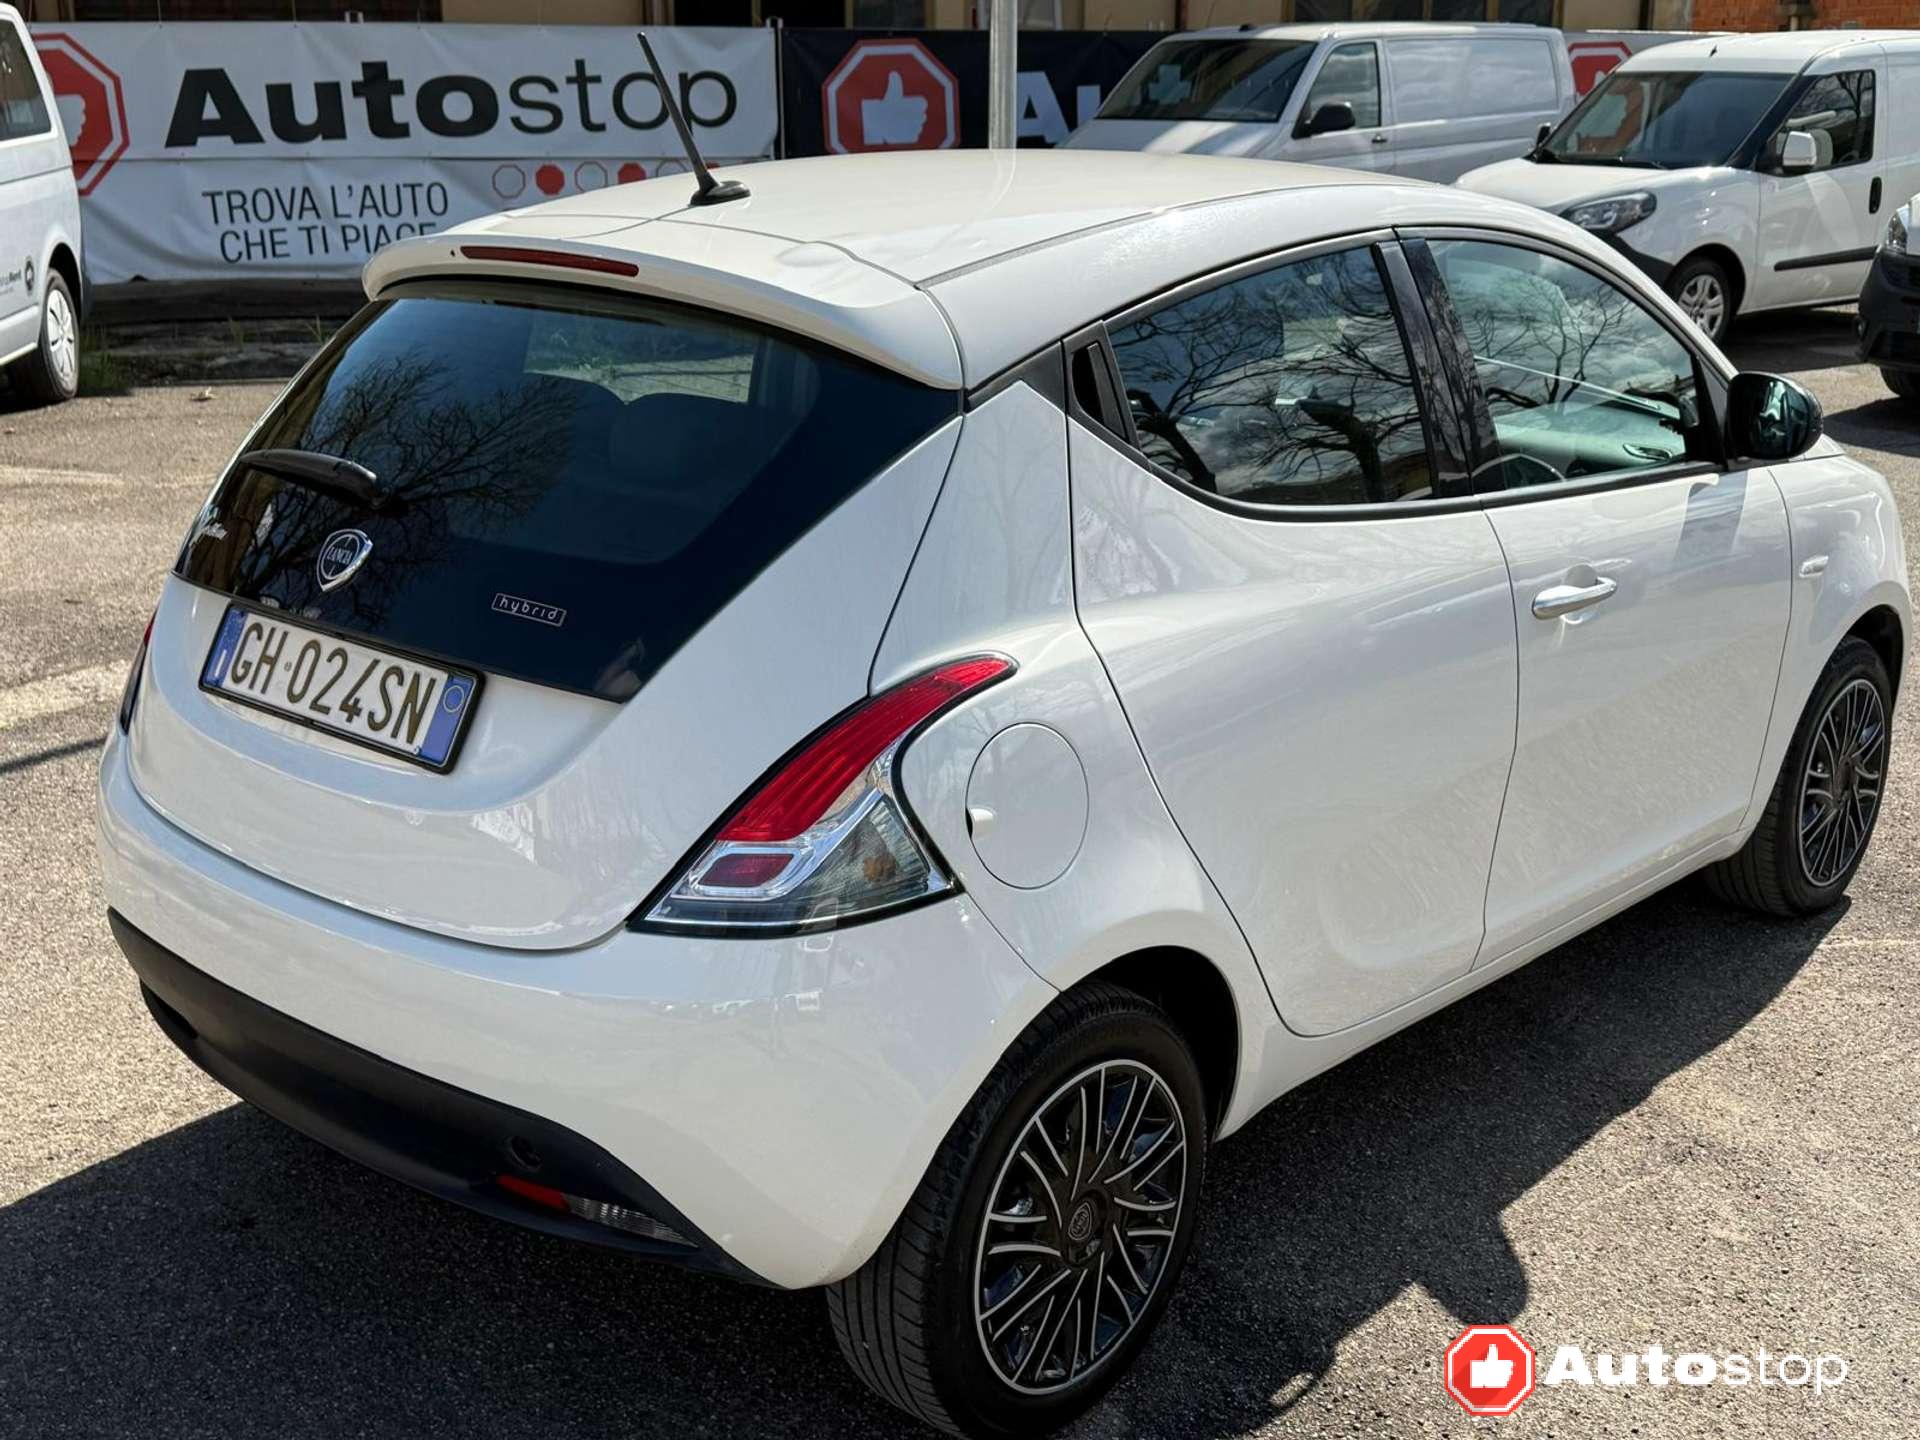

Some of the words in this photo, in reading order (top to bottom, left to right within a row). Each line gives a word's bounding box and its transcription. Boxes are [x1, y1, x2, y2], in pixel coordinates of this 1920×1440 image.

[164, 57, 738, 149] Autostop
[202, 186, 321, 225] TROVA
[331, 182, 449, 219] L'AUTO
[220, 226, 290, 263] CHE
[298, 225, 330, 255] TI
[500, 595, 559, 620] hybrid
